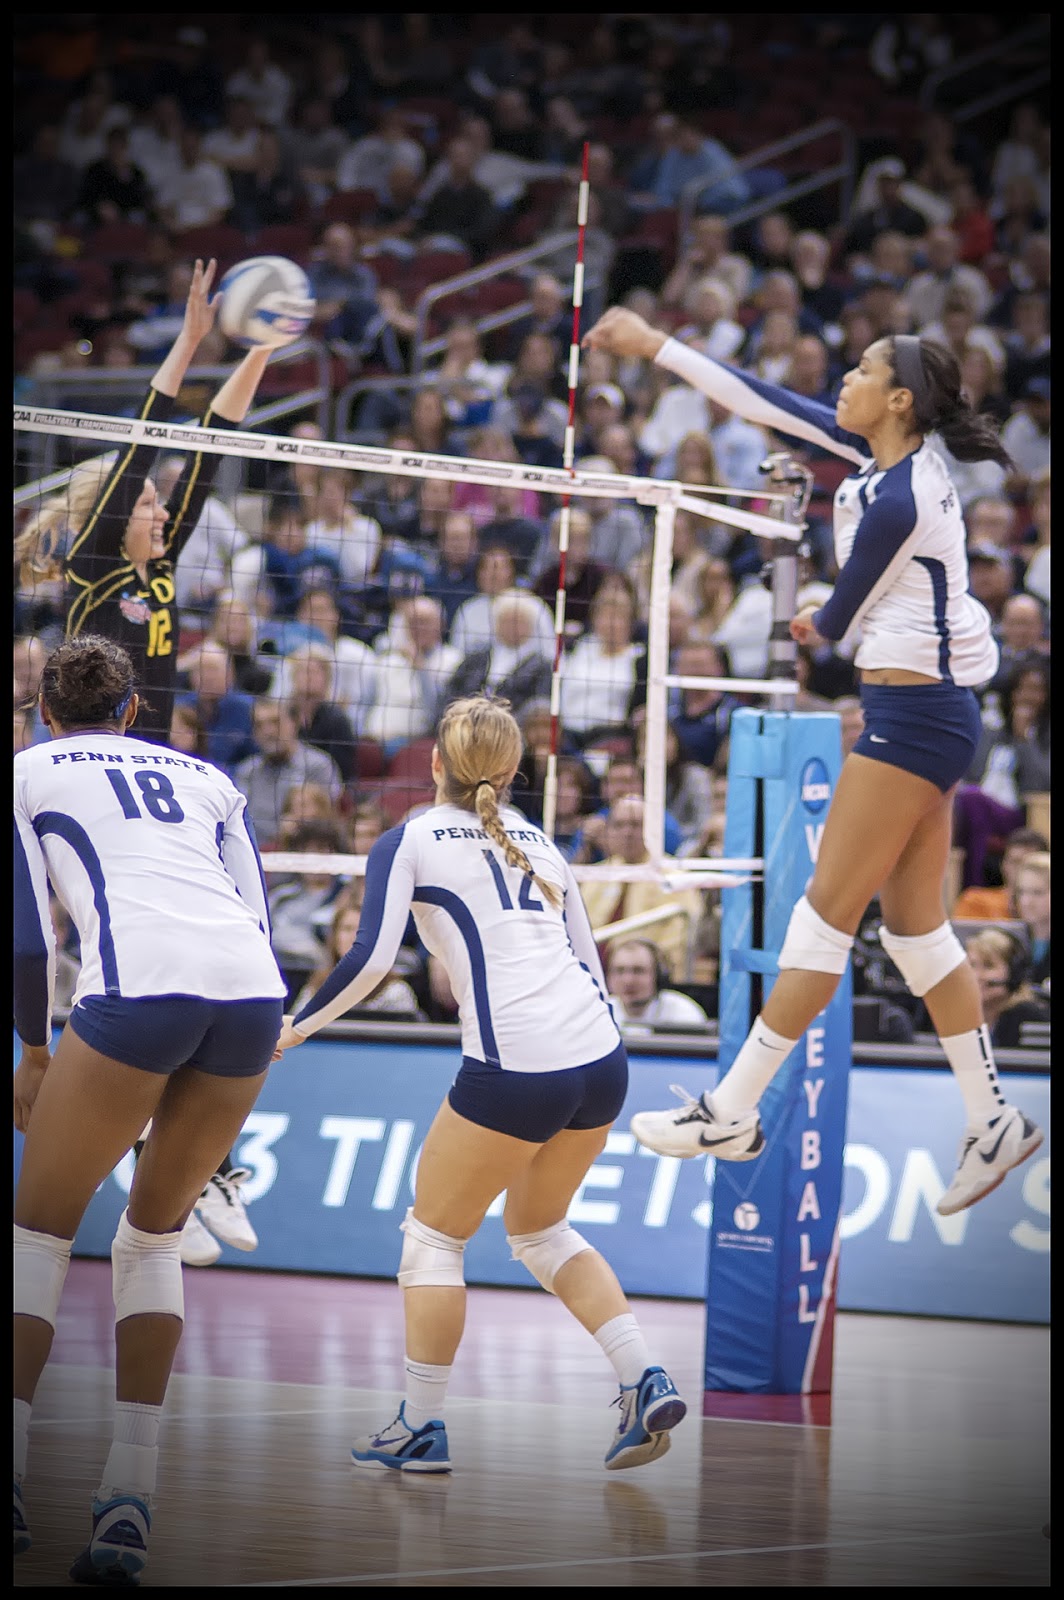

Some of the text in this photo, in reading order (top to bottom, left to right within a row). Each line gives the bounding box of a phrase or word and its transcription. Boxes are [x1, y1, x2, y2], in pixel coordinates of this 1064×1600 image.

[14, 411, 31, 422] CAA
[35, 413, 78, 427] VOLLEYBALL
[78, 418, 132, 434] CHAMPIONSHIP
[143, 426, 168, 438] NCAA
[276, 442, 299, 454] NCAA
[147, 608, 172, 657] 12
[51, 751, 209, 776] PENN STATE
[104, 768, 185, 824] 18
[432, 827, 549, 847] PENN TATE
[481, 848, 544, 912] 12
[797, 823, 825, 1324] VEYBALL
[318, 1112, 714, 1230] TIET
